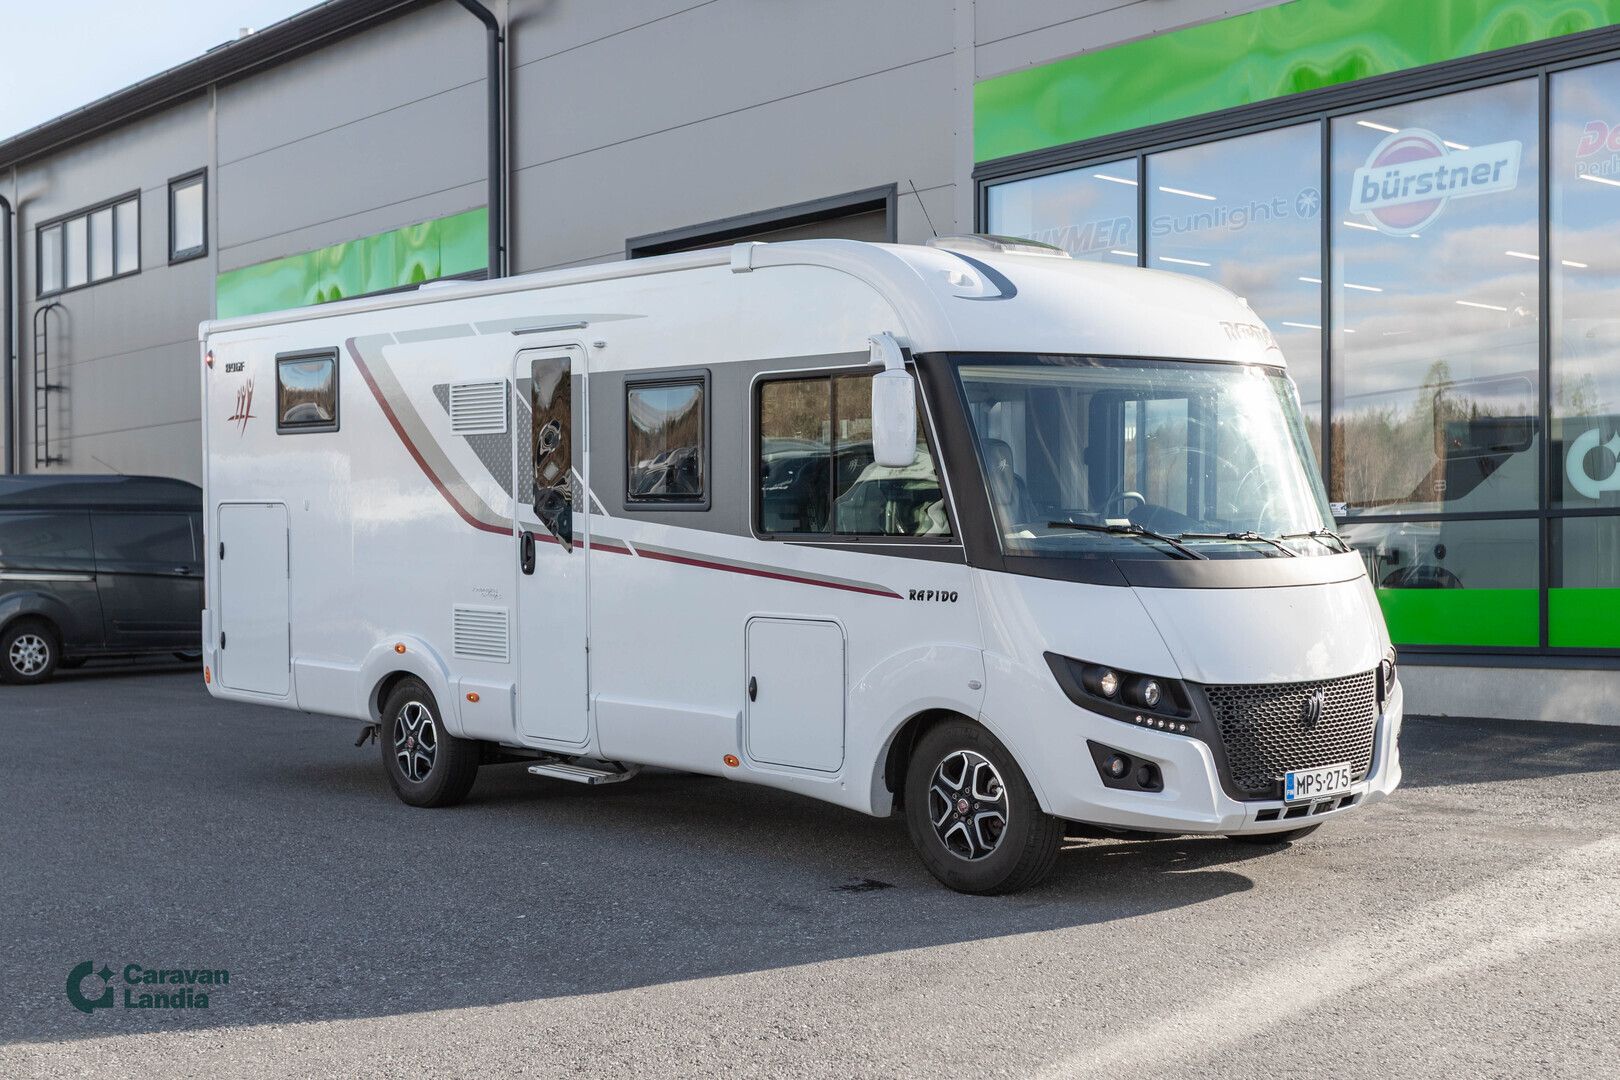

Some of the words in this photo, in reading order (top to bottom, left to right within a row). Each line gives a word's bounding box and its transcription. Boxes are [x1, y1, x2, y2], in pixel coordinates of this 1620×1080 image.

[1360, 158, 1508, 204] bürstner
[1151, 196, 1289, 237] Sunlight
[909, 589, 959, 603] RAPIDO
[1297, 769, 1348, 795] MPS-275
